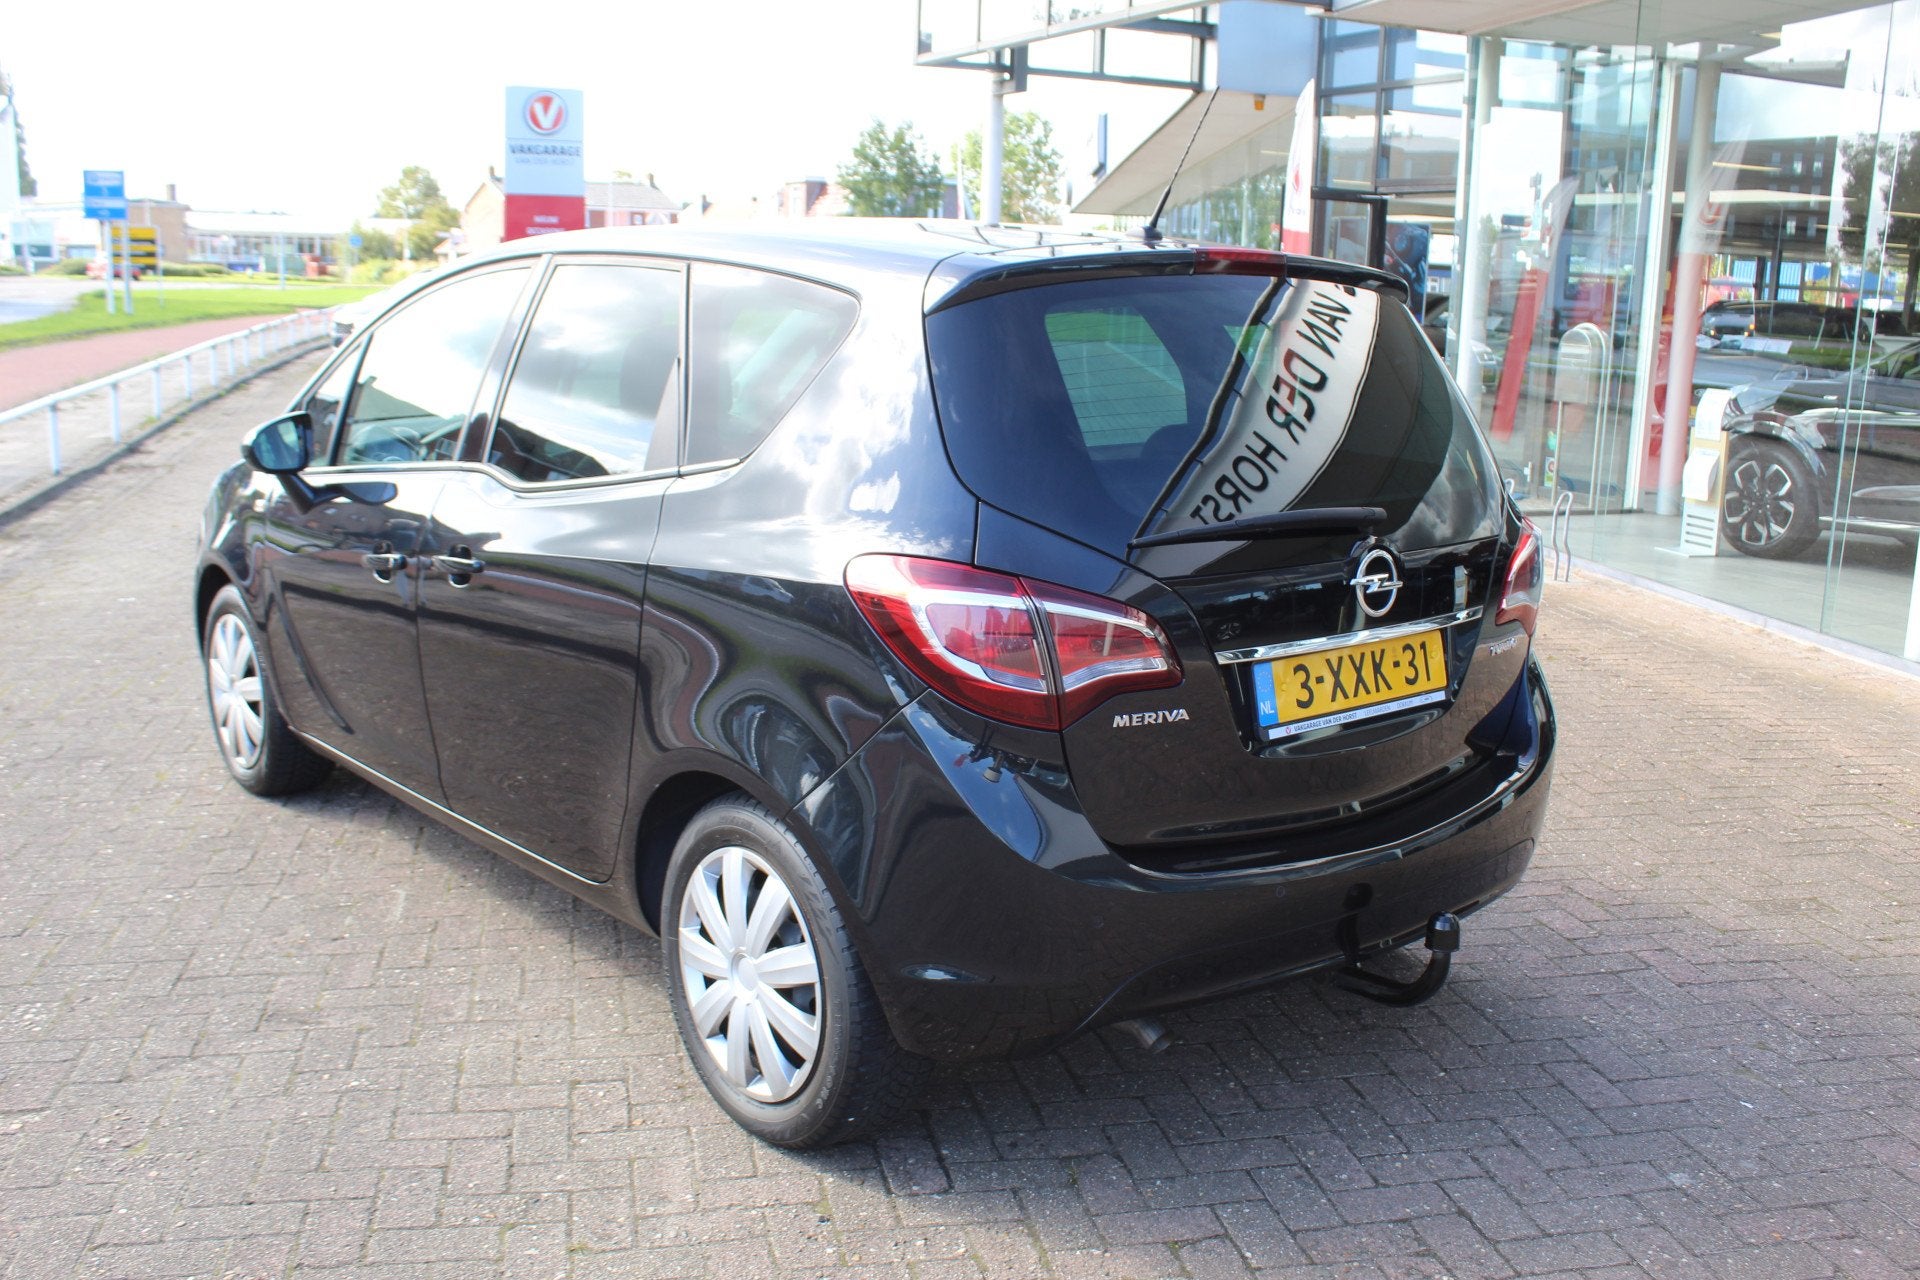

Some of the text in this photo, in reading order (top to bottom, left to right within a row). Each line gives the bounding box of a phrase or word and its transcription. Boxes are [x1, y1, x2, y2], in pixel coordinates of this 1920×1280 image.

[1293, 640, 1431, 709] 3-XXK-31
[1112, 708, 1190, 728] MERIVA
[1260, 701, 1275, 715] NL
[1294, 721, 1321, 732] VAKGARAGE
[1343, 712, 1357, 721] HORST
